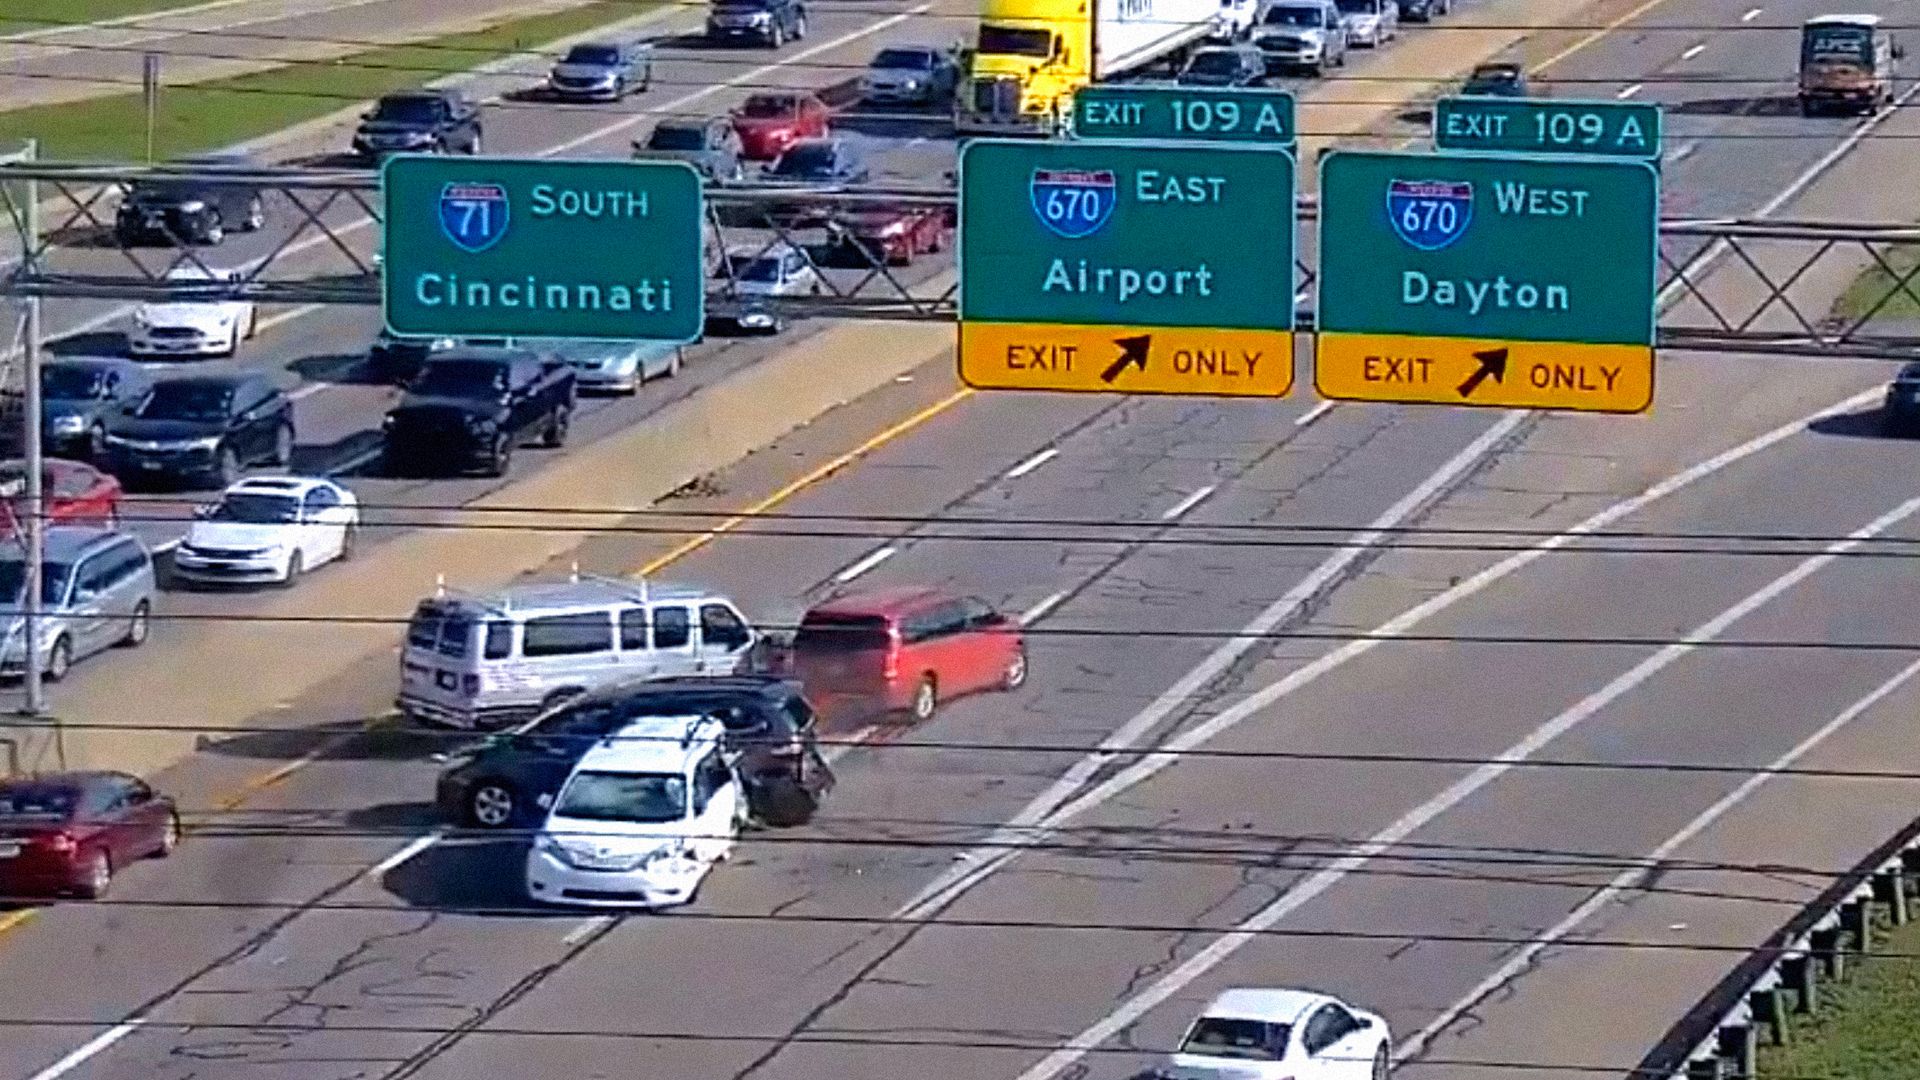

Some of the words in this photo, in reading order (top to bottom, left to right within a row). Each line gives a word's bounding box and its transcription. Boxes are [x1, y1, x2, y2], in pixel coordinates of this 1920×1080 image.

[1085, 101, 1145, 125] EXIT
[1171, 100, 1239, 132] 109
[1255, 103, 1283, 134] A
[1447, 113, 1507, 137] EXIT
[1535, 112, 1603, 144] 109
[1617, 115, 1645, 146] A
[531, 184, 649, 216] SOUTH
[1137, 171, 1225, 202] EAST
[1494, 181, 1589, 217] WEST
[450, 200, 491, 236] 71
[1047, 189, 1100, 221] 670
[1402, 200, 1456, 233] 670
[416, 273, 672, 312] Cincinnati
[1042, 259, 1213, 301] Airport
[1402, 271, 1569, 314] Dayton
[1007, 345, 1079, 371] EXIT
[1173, 350, 1263, 377] ONLY
[1364, 356, 1434, 382] EXIT
[1531, 363, 1621, 392] ONLY
